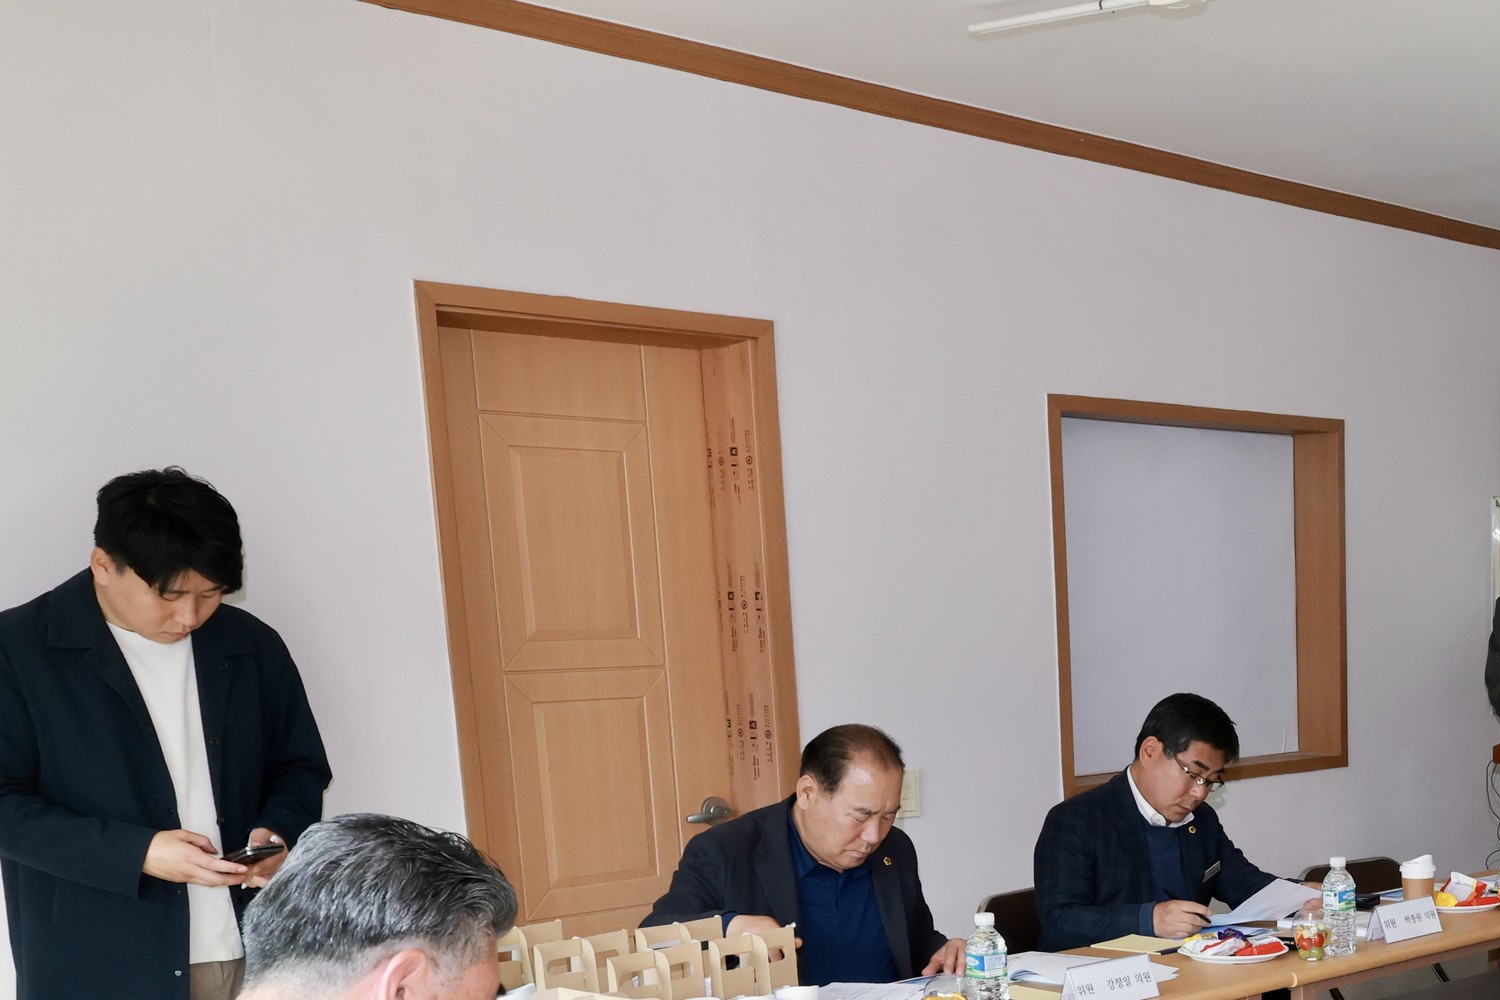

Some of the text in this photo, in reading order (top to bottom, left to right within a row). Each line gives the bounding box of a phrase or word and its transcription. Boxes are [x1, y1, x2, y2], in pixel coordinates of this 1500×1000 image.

[1383, 917, 1397, 929] 위원
[1424, 909, 1437, 921] 의원
[1077, 971, 1152, 997] 위원 강정일 의원
